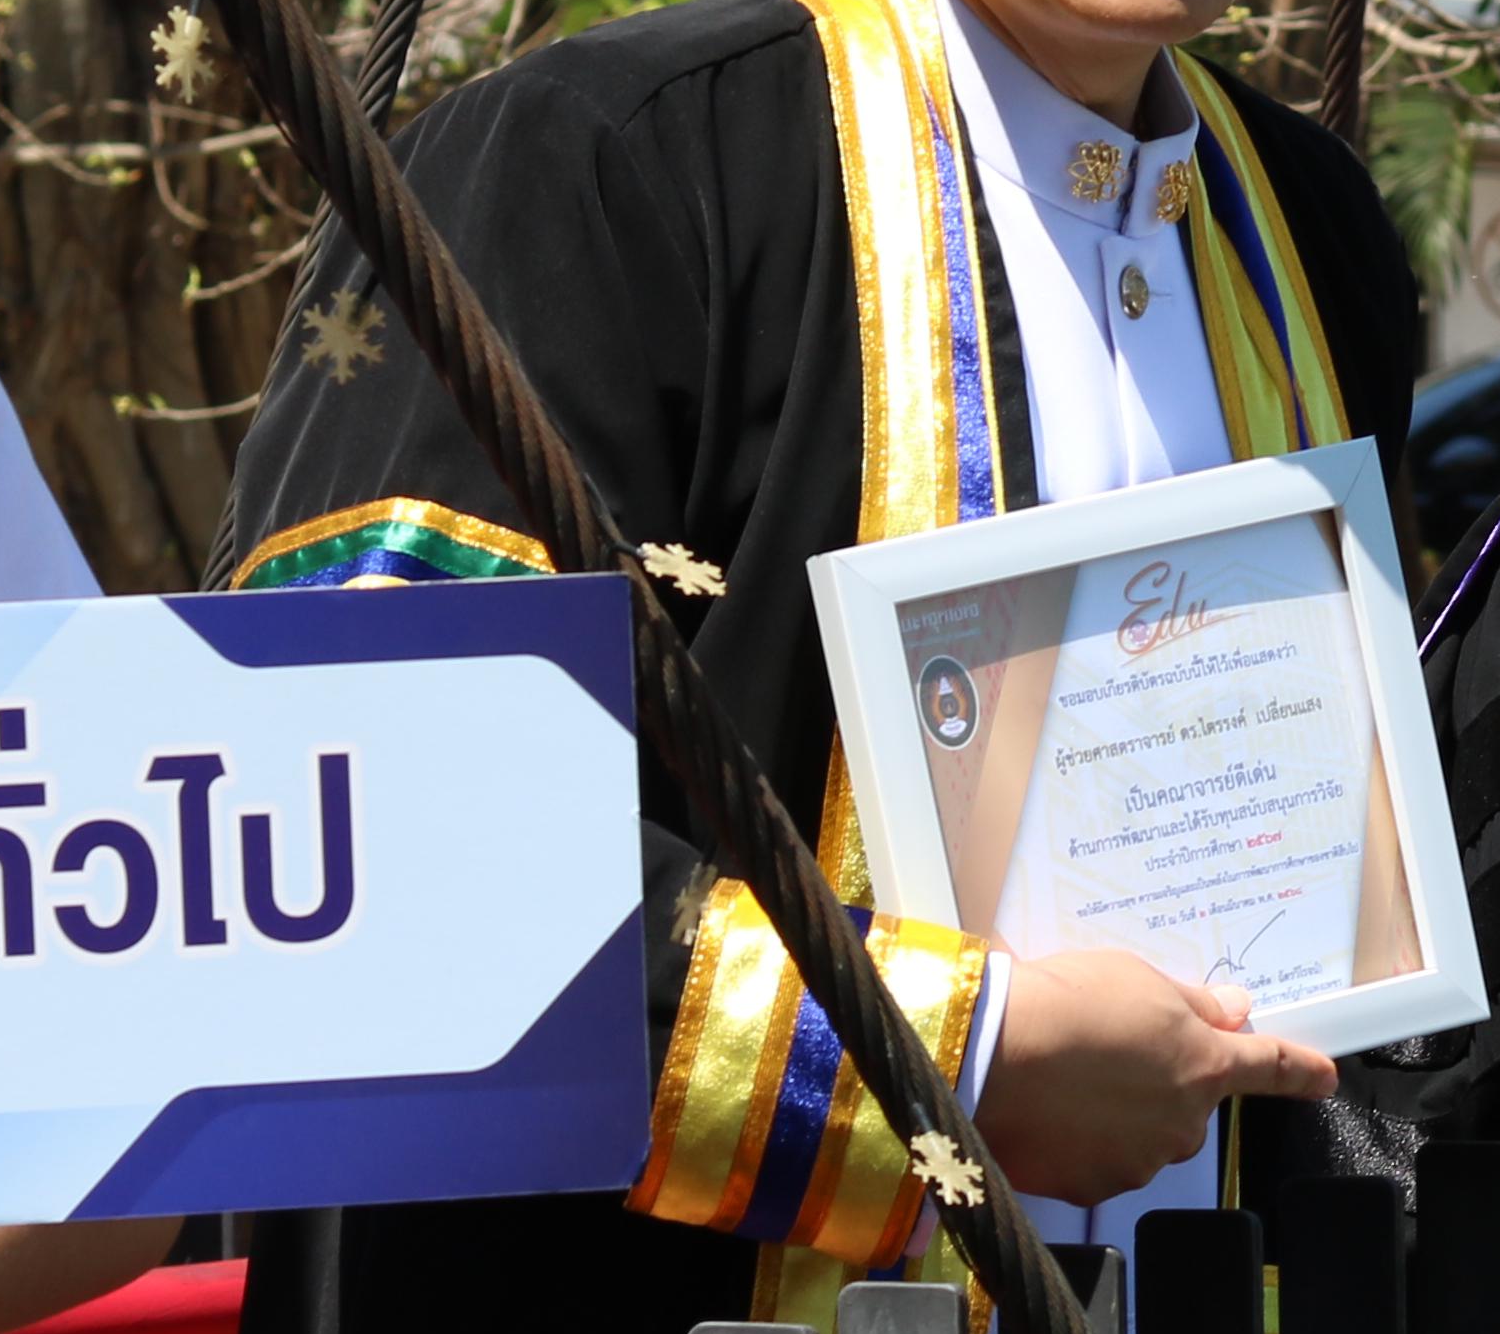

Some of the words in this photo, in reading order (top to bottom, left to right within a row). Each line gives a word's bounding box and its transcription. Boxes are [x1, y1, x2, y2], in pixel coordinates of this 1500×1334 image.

[1117, 560, 1208, 656] Edu
[1125, 759, 1277, 814] เป็นคณาจารย์ดีเด่น
